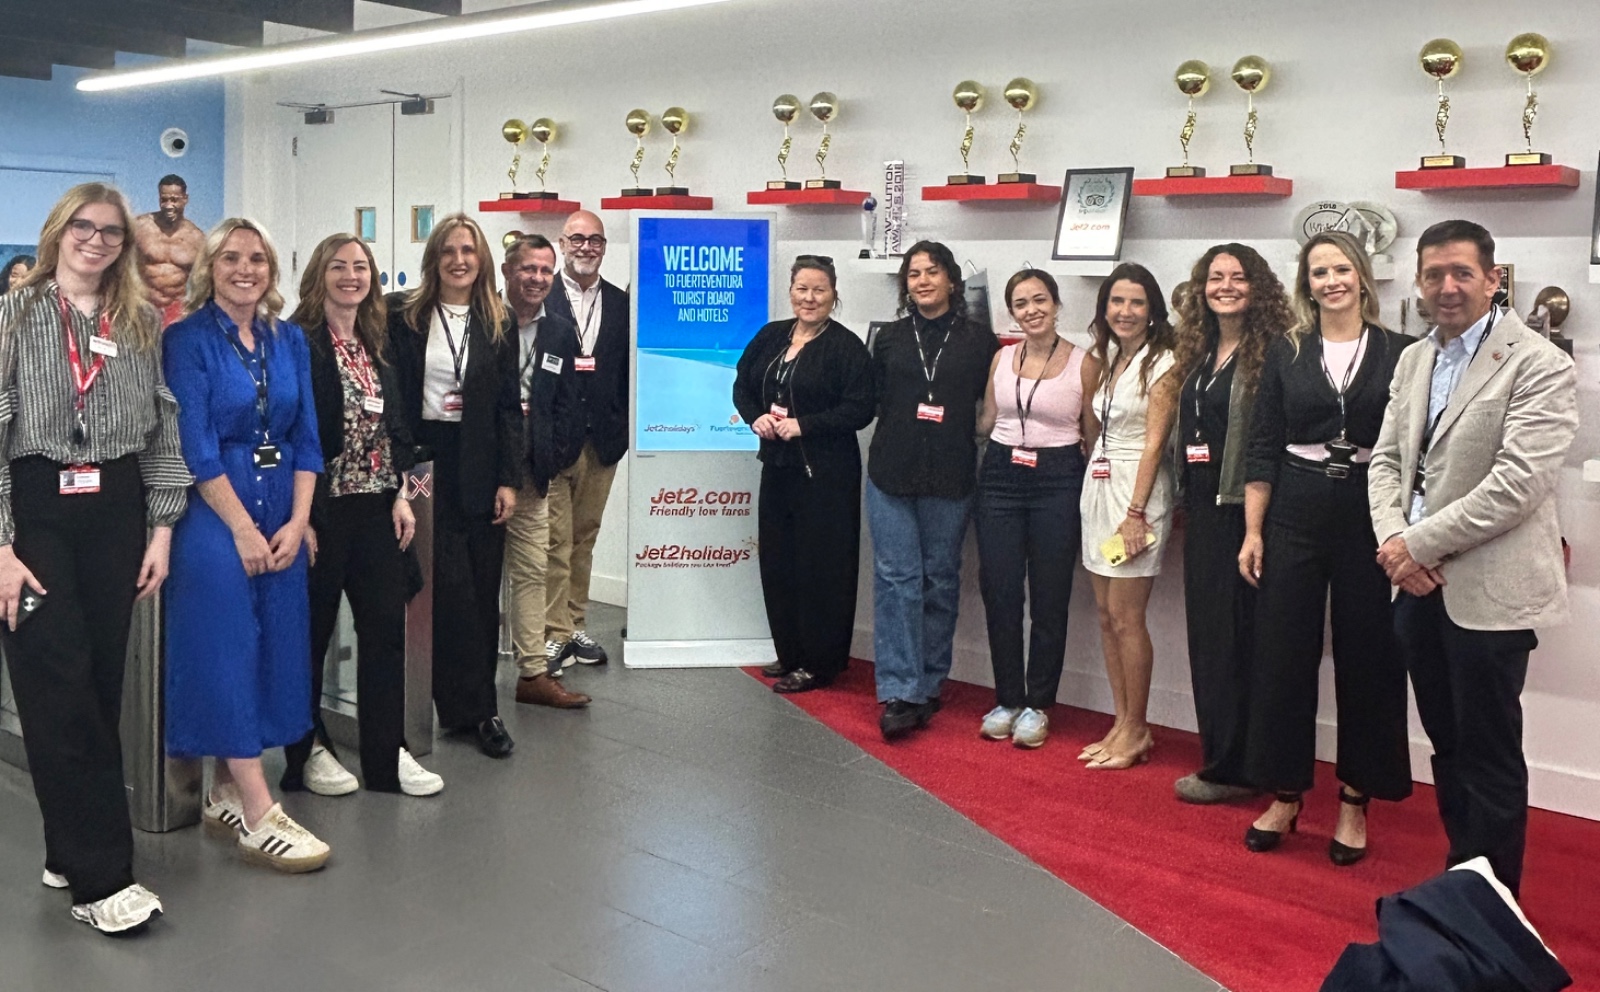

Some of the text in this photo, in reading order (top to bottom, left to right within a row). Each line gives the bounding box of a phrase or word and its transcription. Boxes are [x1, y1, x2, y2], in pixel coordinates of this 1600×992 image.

[1069, 223, 1111, 231] Jet2com
[663, 245, 744, 272] WELCOME
[664, 273, 743, 289] TO FUERTEVENTURA
[672, 290, 735, 306] TOURIST BOARD
[677, 307, 729, 323] AND HOTELS
[644, 424, 695, 434] Jet2holidays
[650, 487, 752, 505] Jet2.com
[649, 506, 750, 518] Friendly low fares
[635, 544, 751, 564] Jet2holidays
